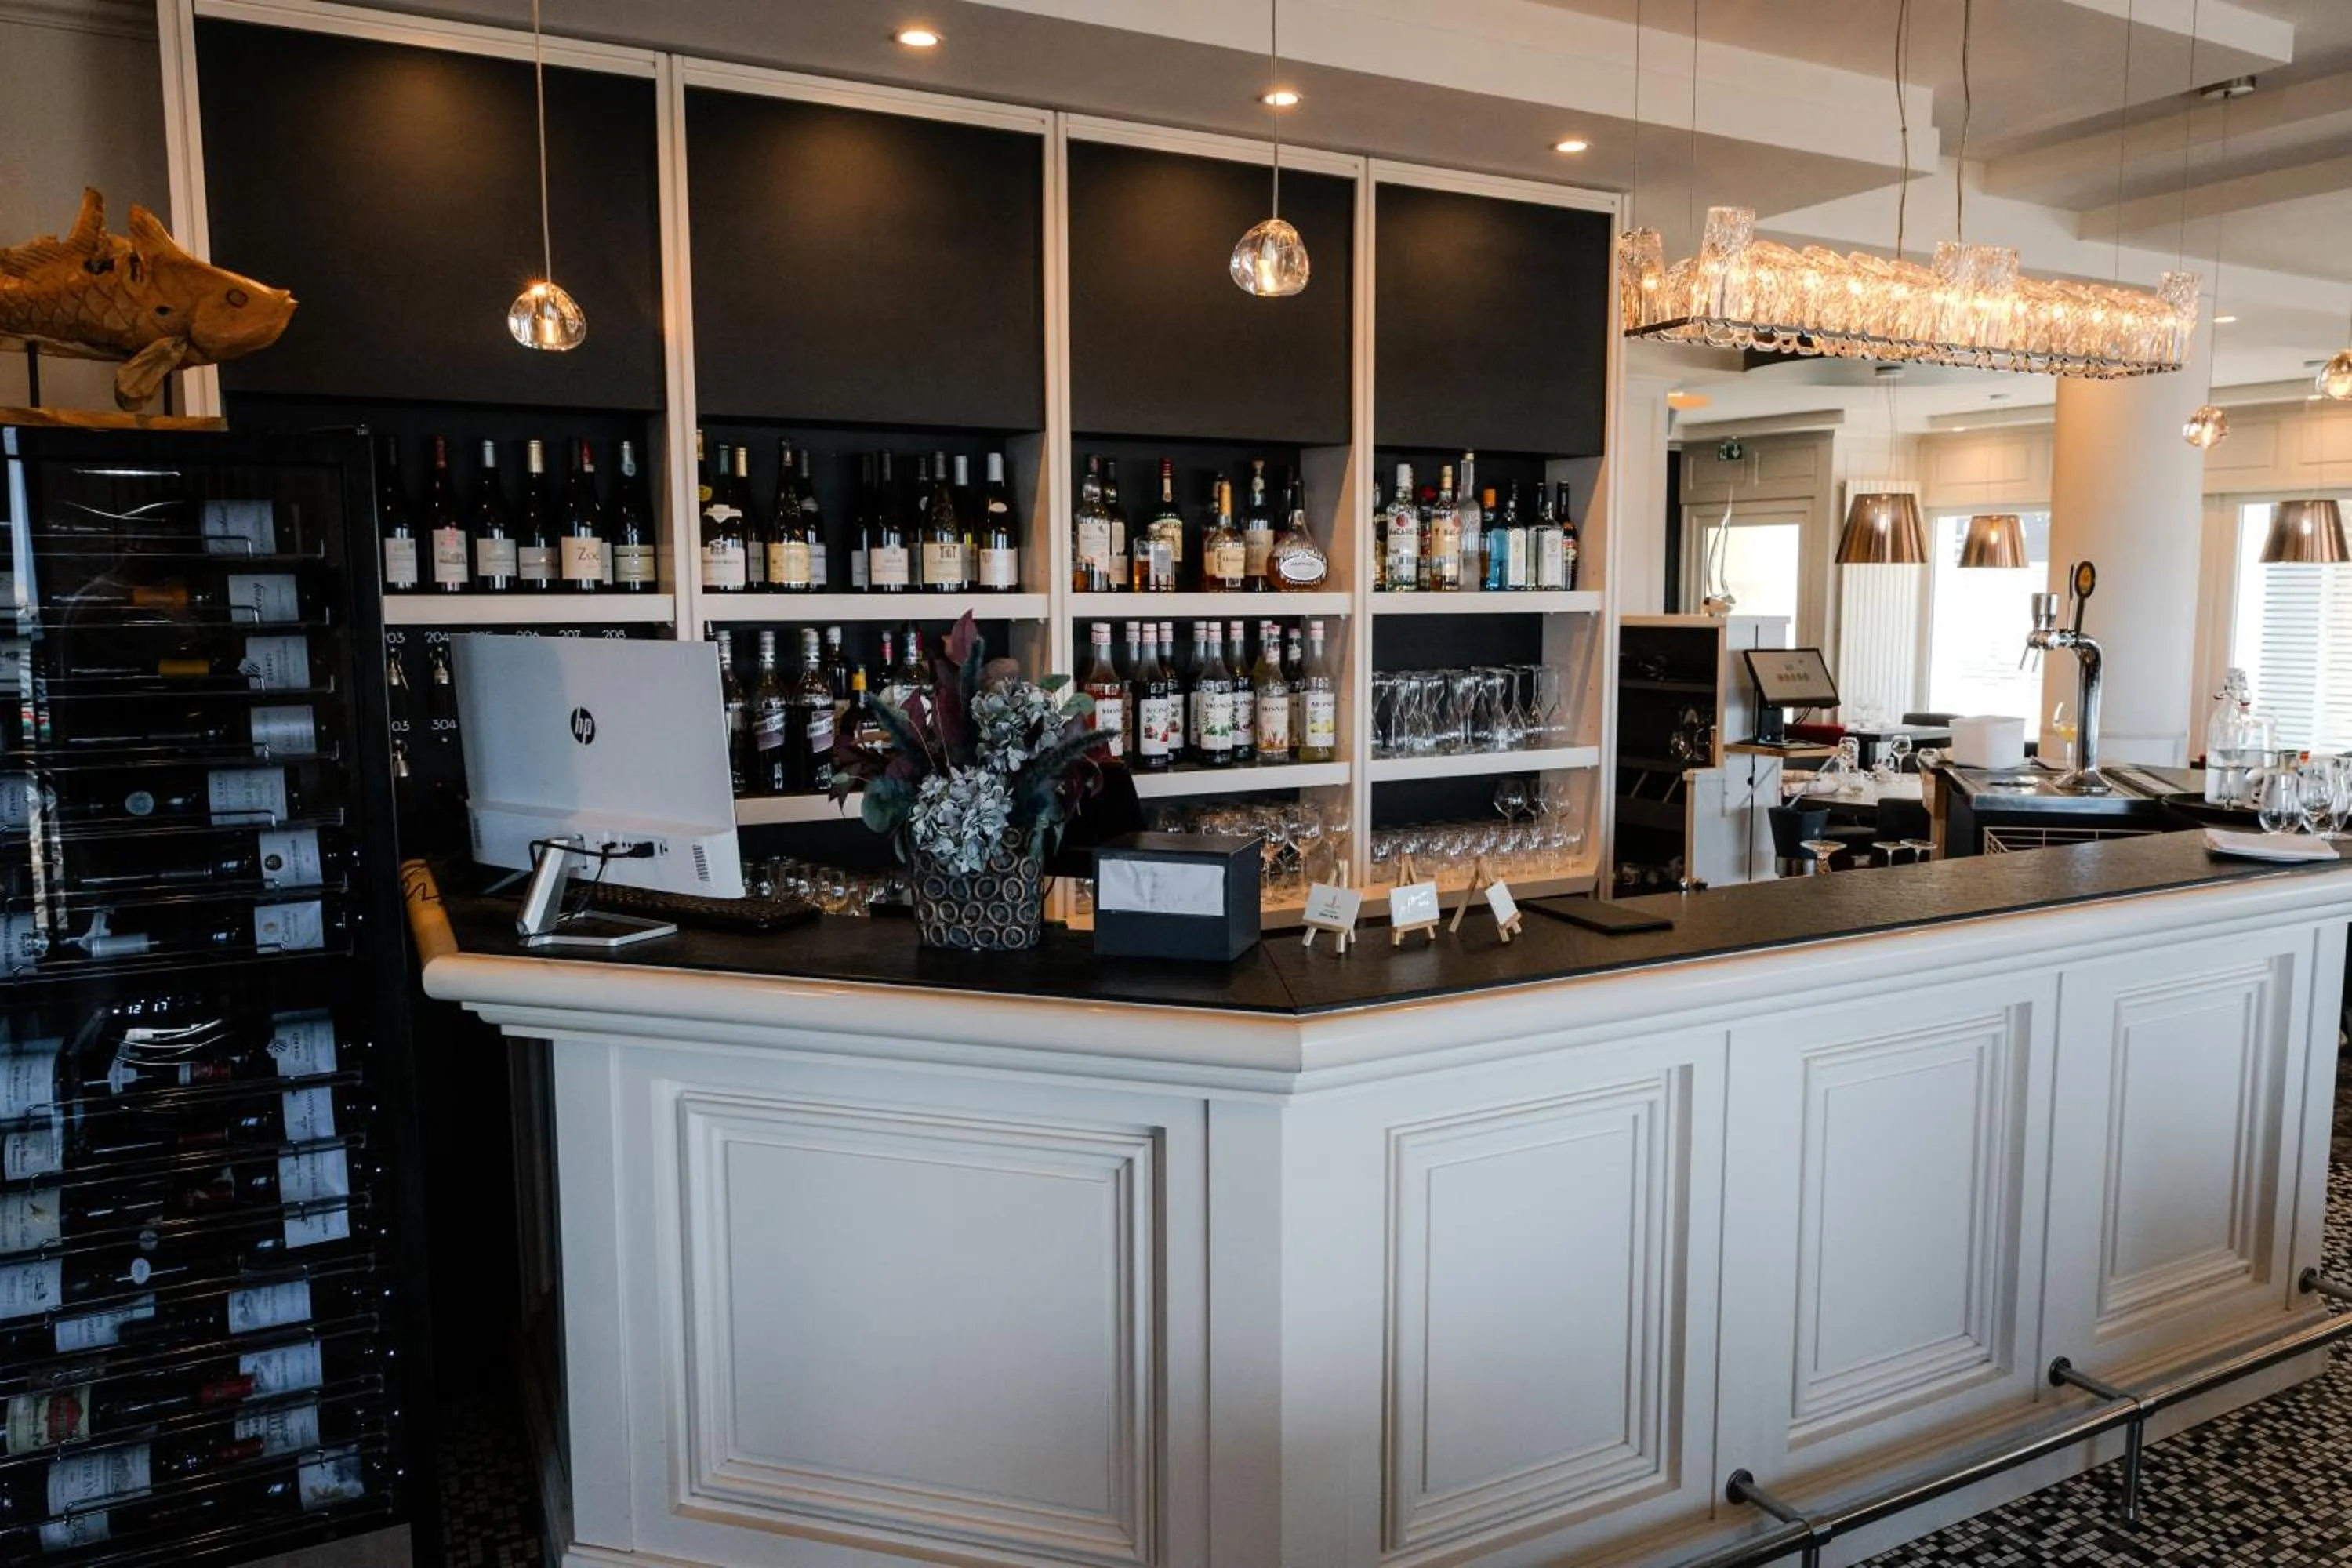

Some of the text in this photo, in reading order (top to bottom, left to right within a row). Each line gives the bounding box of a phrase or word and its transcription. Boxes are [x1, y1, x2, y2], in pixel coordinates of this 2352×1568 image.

[387, 631, 449, 643] 03 204
[391, 719, 457, 731] 03 304
[574, 706, 593, 746] hp
